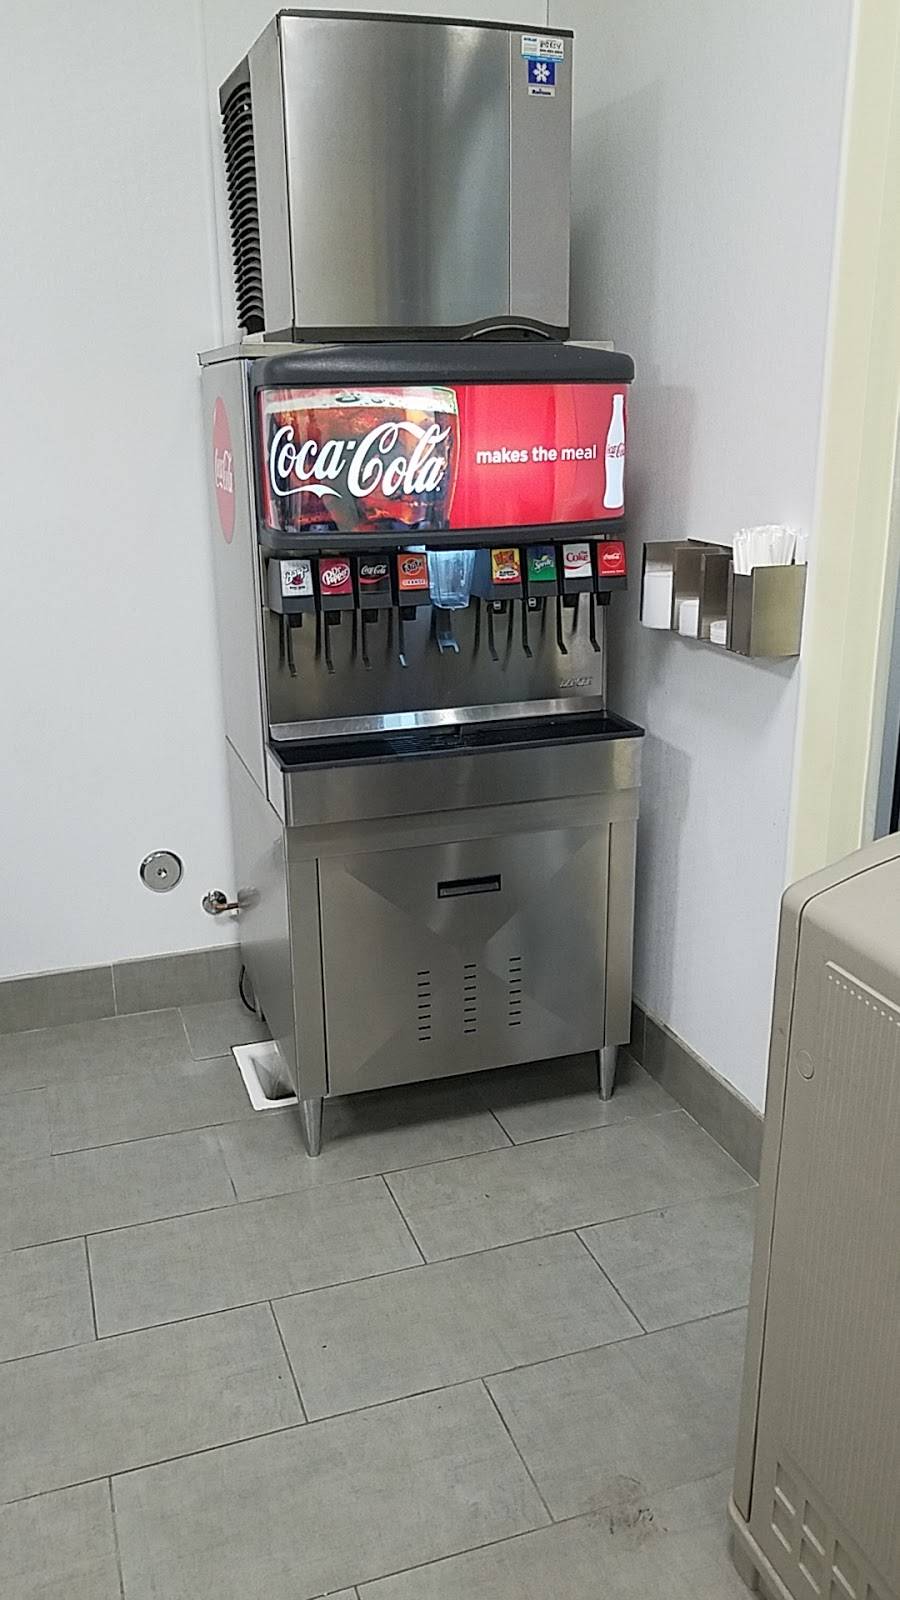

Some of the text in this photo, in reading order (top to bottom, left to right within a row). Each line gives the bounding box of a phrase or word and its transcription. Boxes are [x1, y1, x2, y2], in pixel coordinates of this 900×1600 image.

[269, 422, 451, 498] Coca-Cola
[476, 444, 597, 464] makes the meal
[566, 551, 588, 563] Coke
[325, 569, 349, 585] Pepper
